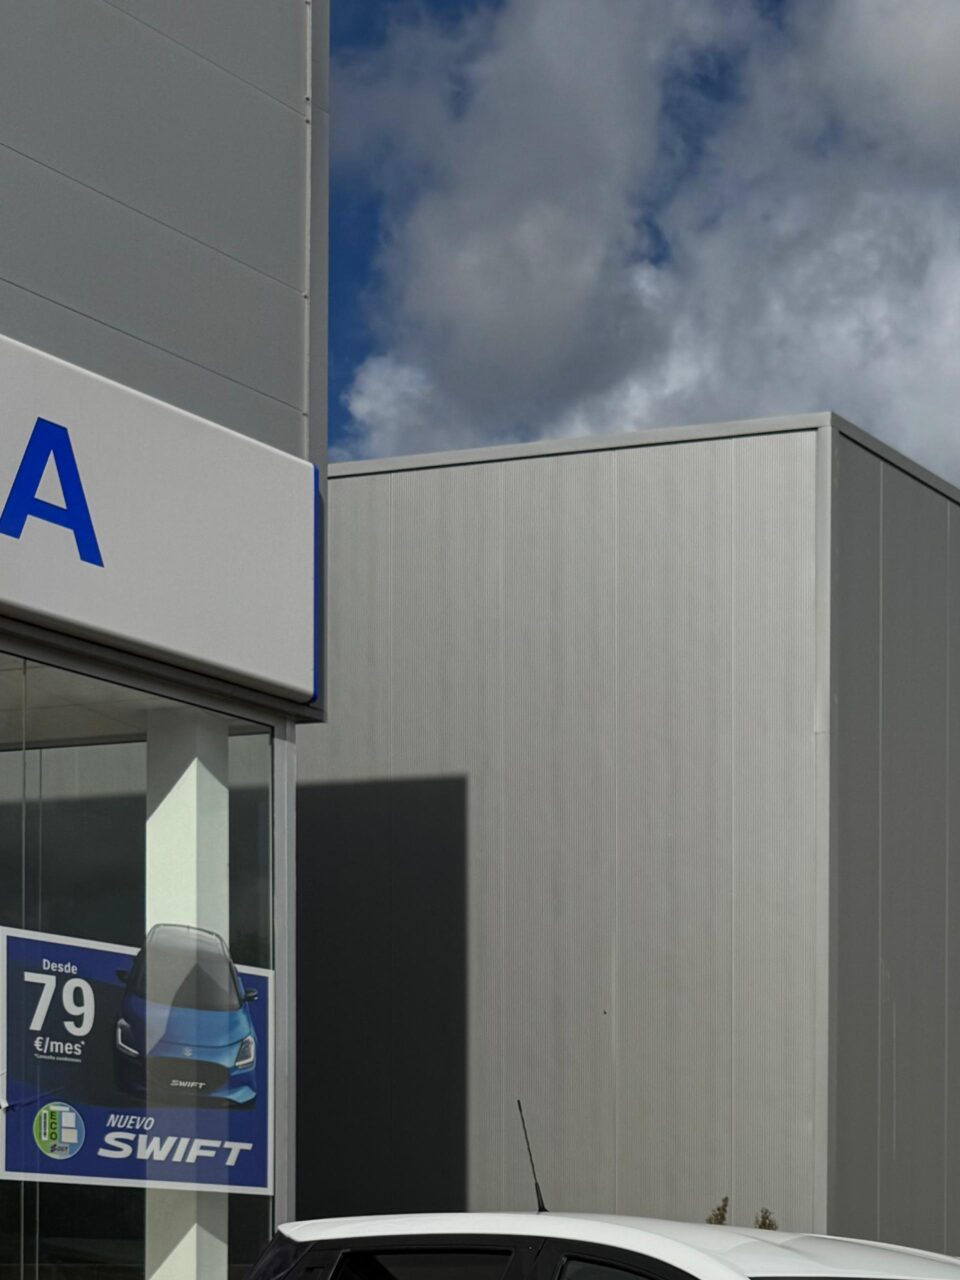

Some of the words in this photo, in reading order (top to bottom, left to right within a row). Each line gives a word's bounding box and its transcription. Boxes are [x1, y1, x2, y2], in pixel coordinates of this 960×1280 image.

[0, 417, 104, 568] A
[42, 958, 78, 975] Desde
[23, 971, 96, 1037] 79
[170, 1079, 206, 1089] SWIFT
[106, 1114, 155, 1131] NUEVO
[97, 1131, 253, 1166] SWIFT
